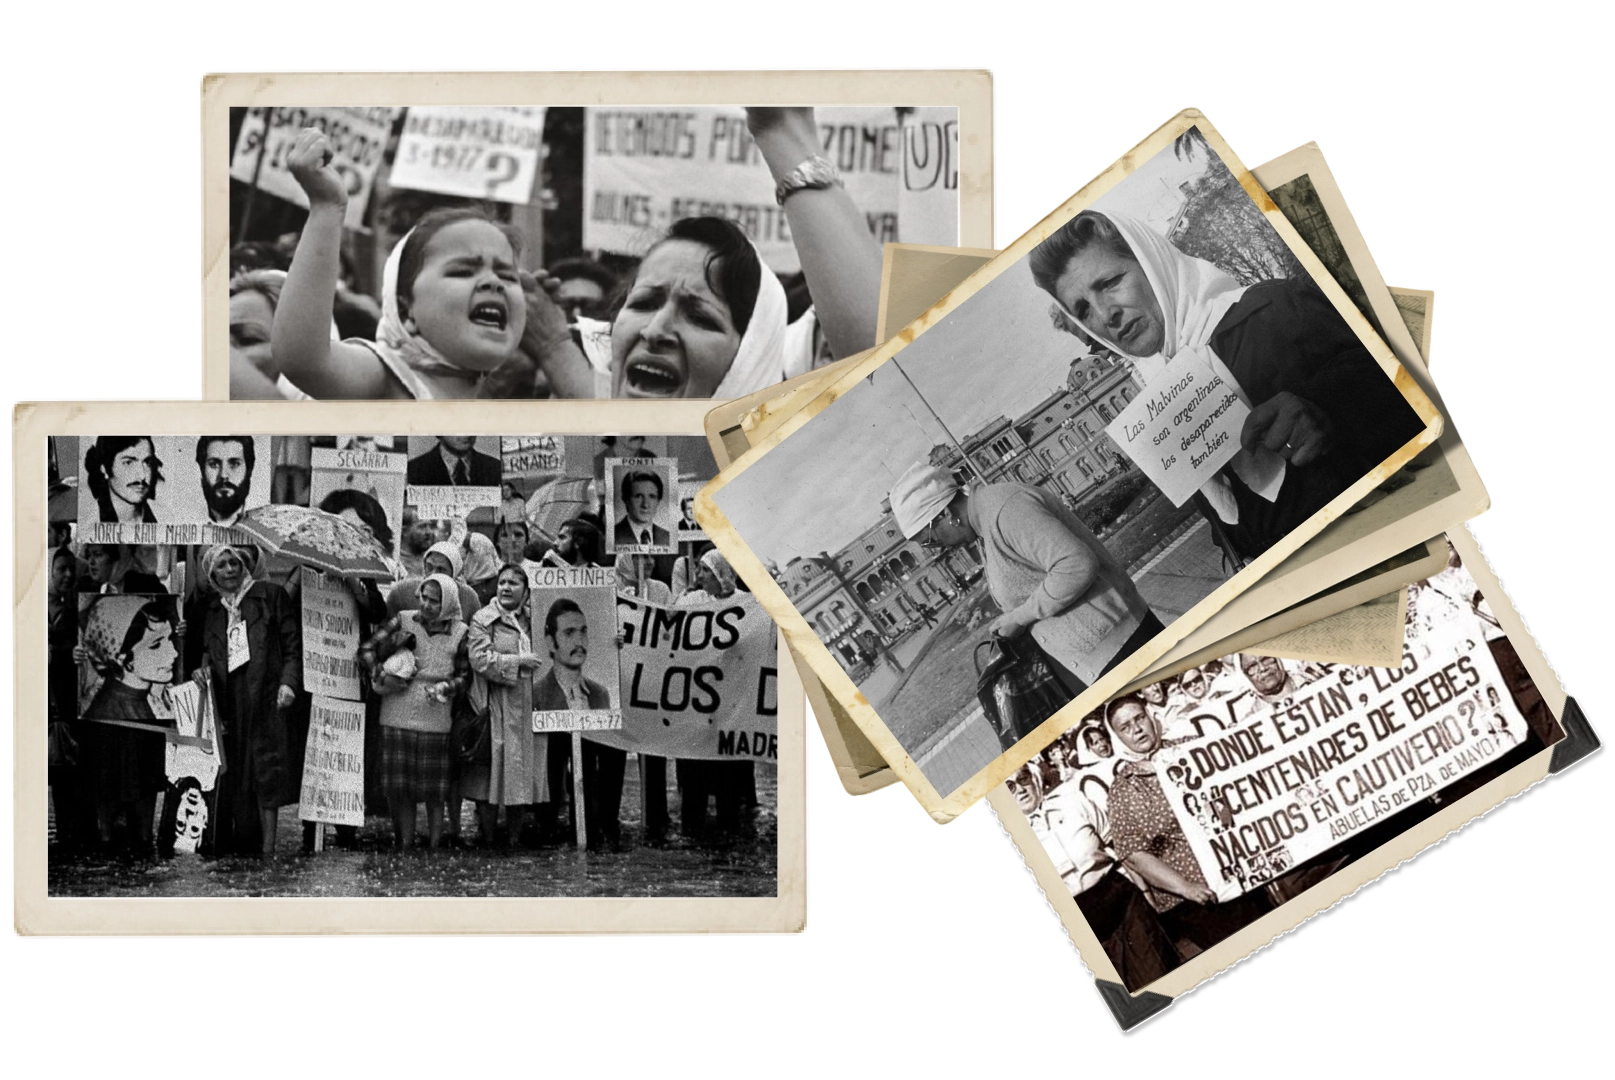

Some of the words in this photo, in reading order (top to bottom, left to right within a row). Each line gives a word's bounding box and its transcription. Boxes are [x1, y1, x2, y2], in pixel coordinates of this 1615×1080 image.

[1123, 419, 1146, 443] Las
[1145, 371, 1195, 422] Malvinas
[1152, 426, 1171, 447] son
[1160, 453, 1177, 471] los
[1180, 392, 1239, 452] desaparecidos
[337, 449, 389, 469] SEGARRA
[1189, 430, 1230, 470] también
[90, 522, 123, 544] JORGE
[165, 523, 198, 543] MARIA
[630, 662, 724, 714] LOS
[1219, 721, 1369, 816] CENTENARES
[1366, 699, 1407, 742] DE
[1400, 655, 1480, 721] BEBES
[1328, 794, 1392, 841] ABUELAS
[1391, 787, 1411, 806] DE
[1438, 761, 1459, 781] DE
[1453, 737, 1496, 774] MAYO
[1208, 802, 1310, 874] NACIDOS
[1309, 793, 1341, 824] EN
